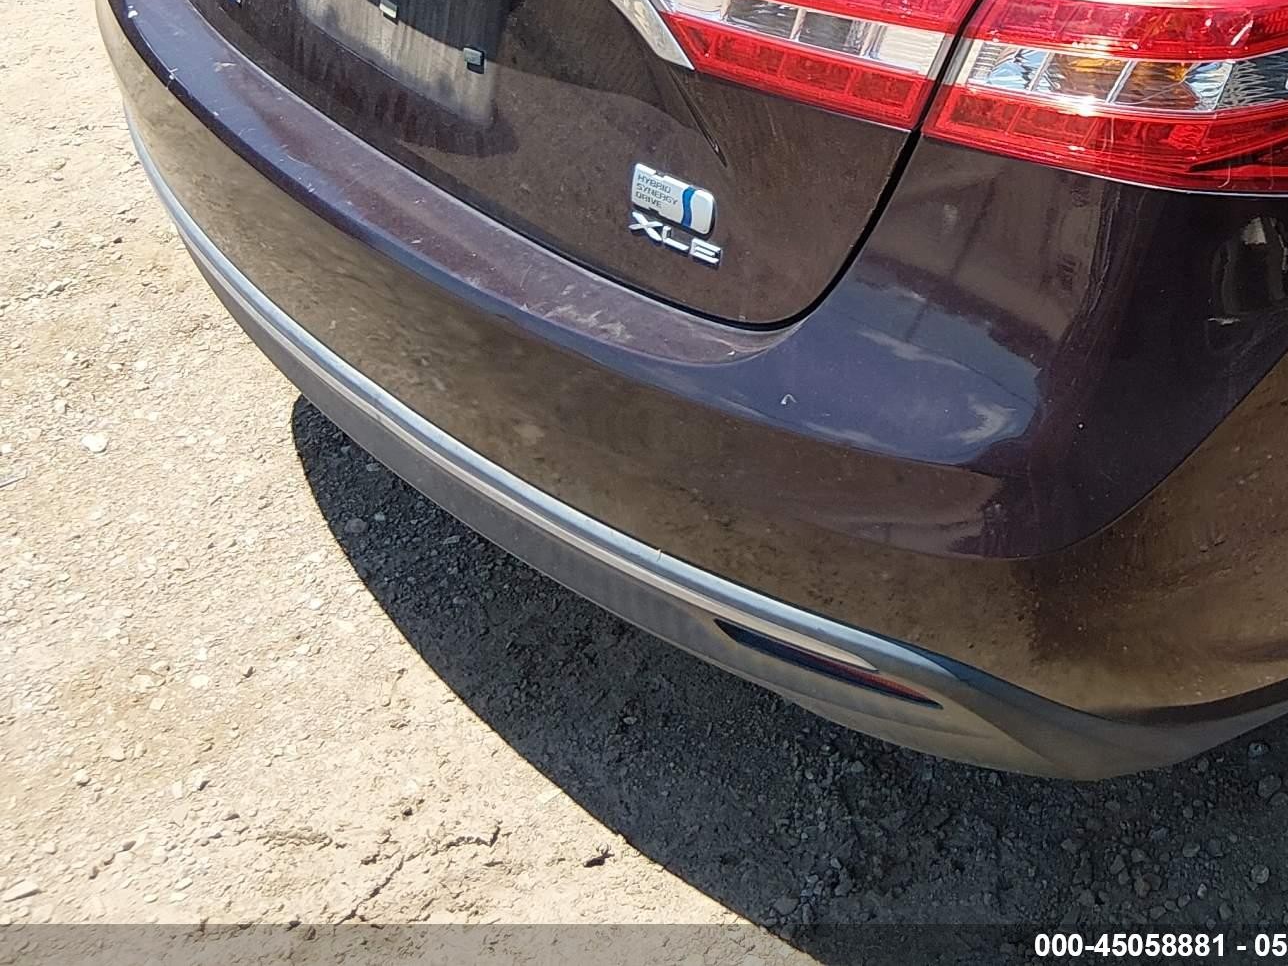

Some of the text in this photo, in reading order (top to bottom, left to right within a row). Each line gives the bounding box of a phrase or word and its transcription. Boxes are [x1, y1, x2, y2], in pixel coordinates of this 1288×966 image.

[635, 182, 678, 206] SYNERGY
[637, 173, 672, 194] HYBRID
[634, 190, 662, 208] DRIVE
[628, 211, 723, 265] XLE
